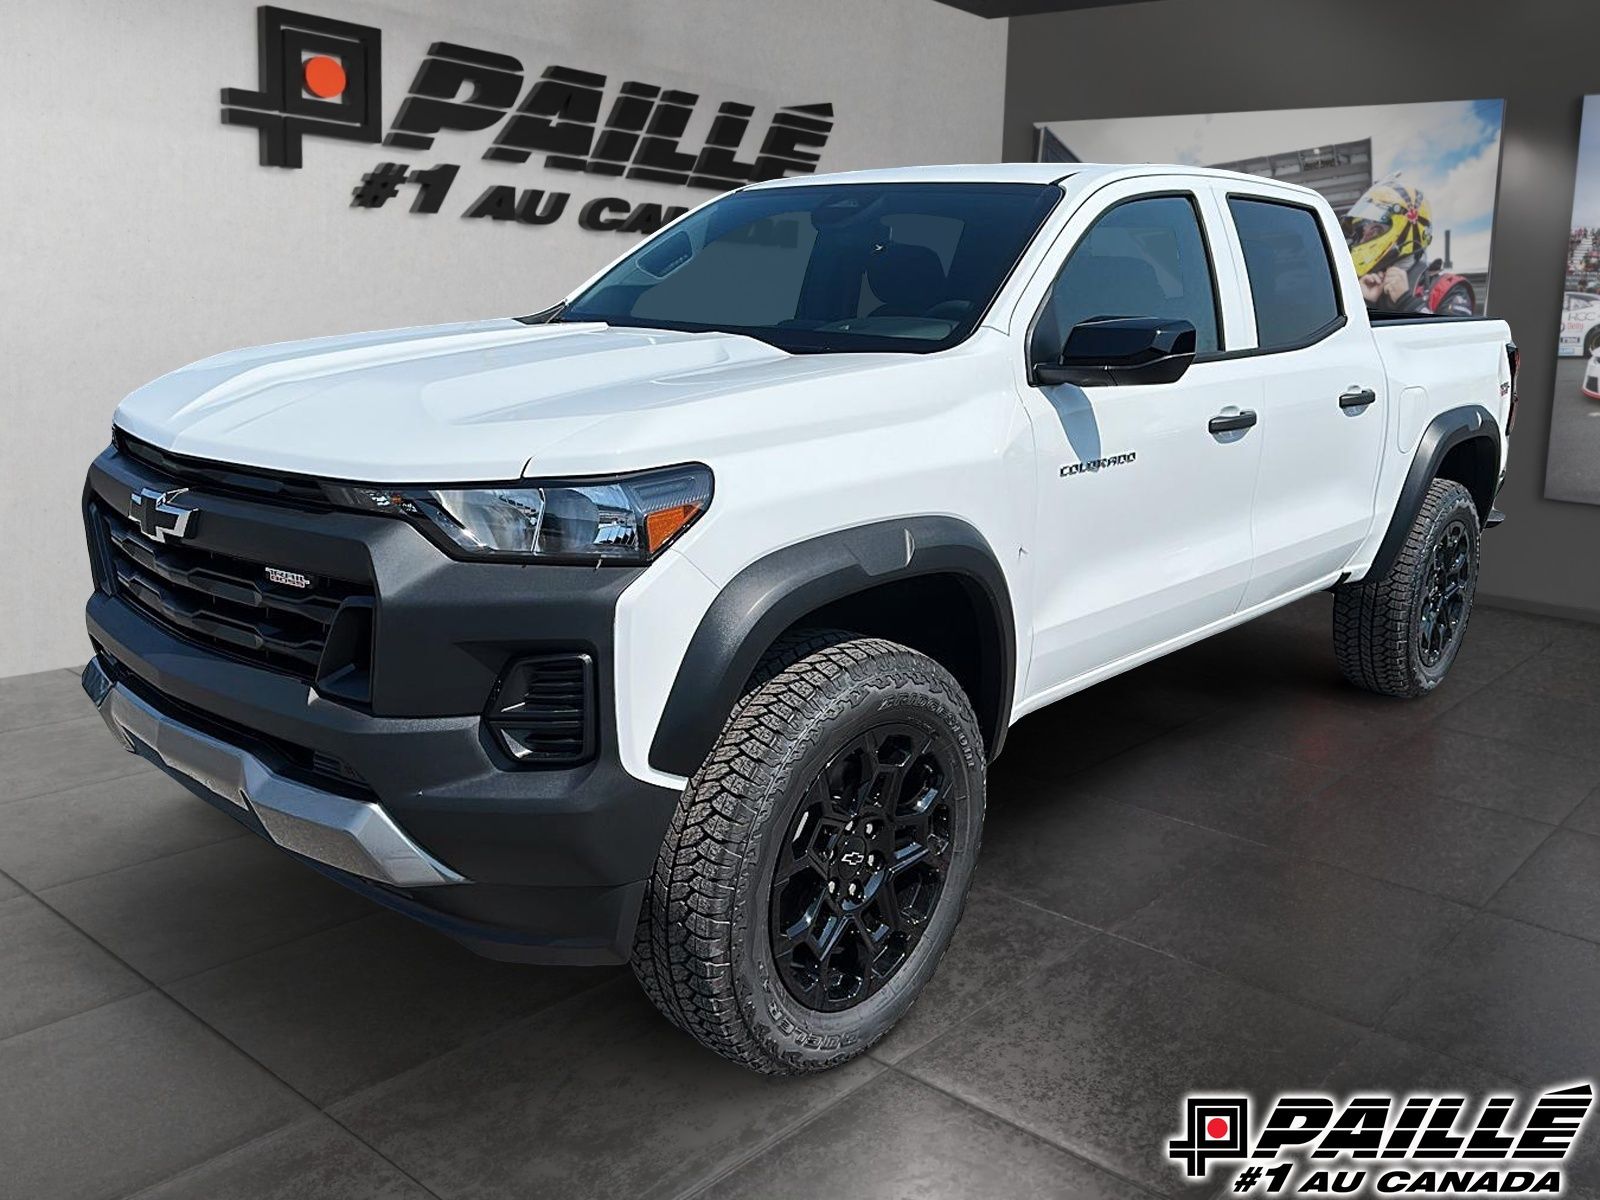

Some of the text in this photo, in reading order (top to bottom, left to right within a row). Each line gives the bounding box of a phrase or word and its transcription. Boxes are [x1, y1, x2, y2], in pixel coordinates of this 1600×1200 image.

[382, 41, 834, 190] PAILLÉ
[349, 162, 460, 214] #1
[461, 185, 571, 225] AU
[1059, 452, 1136, 477] COLORADO
